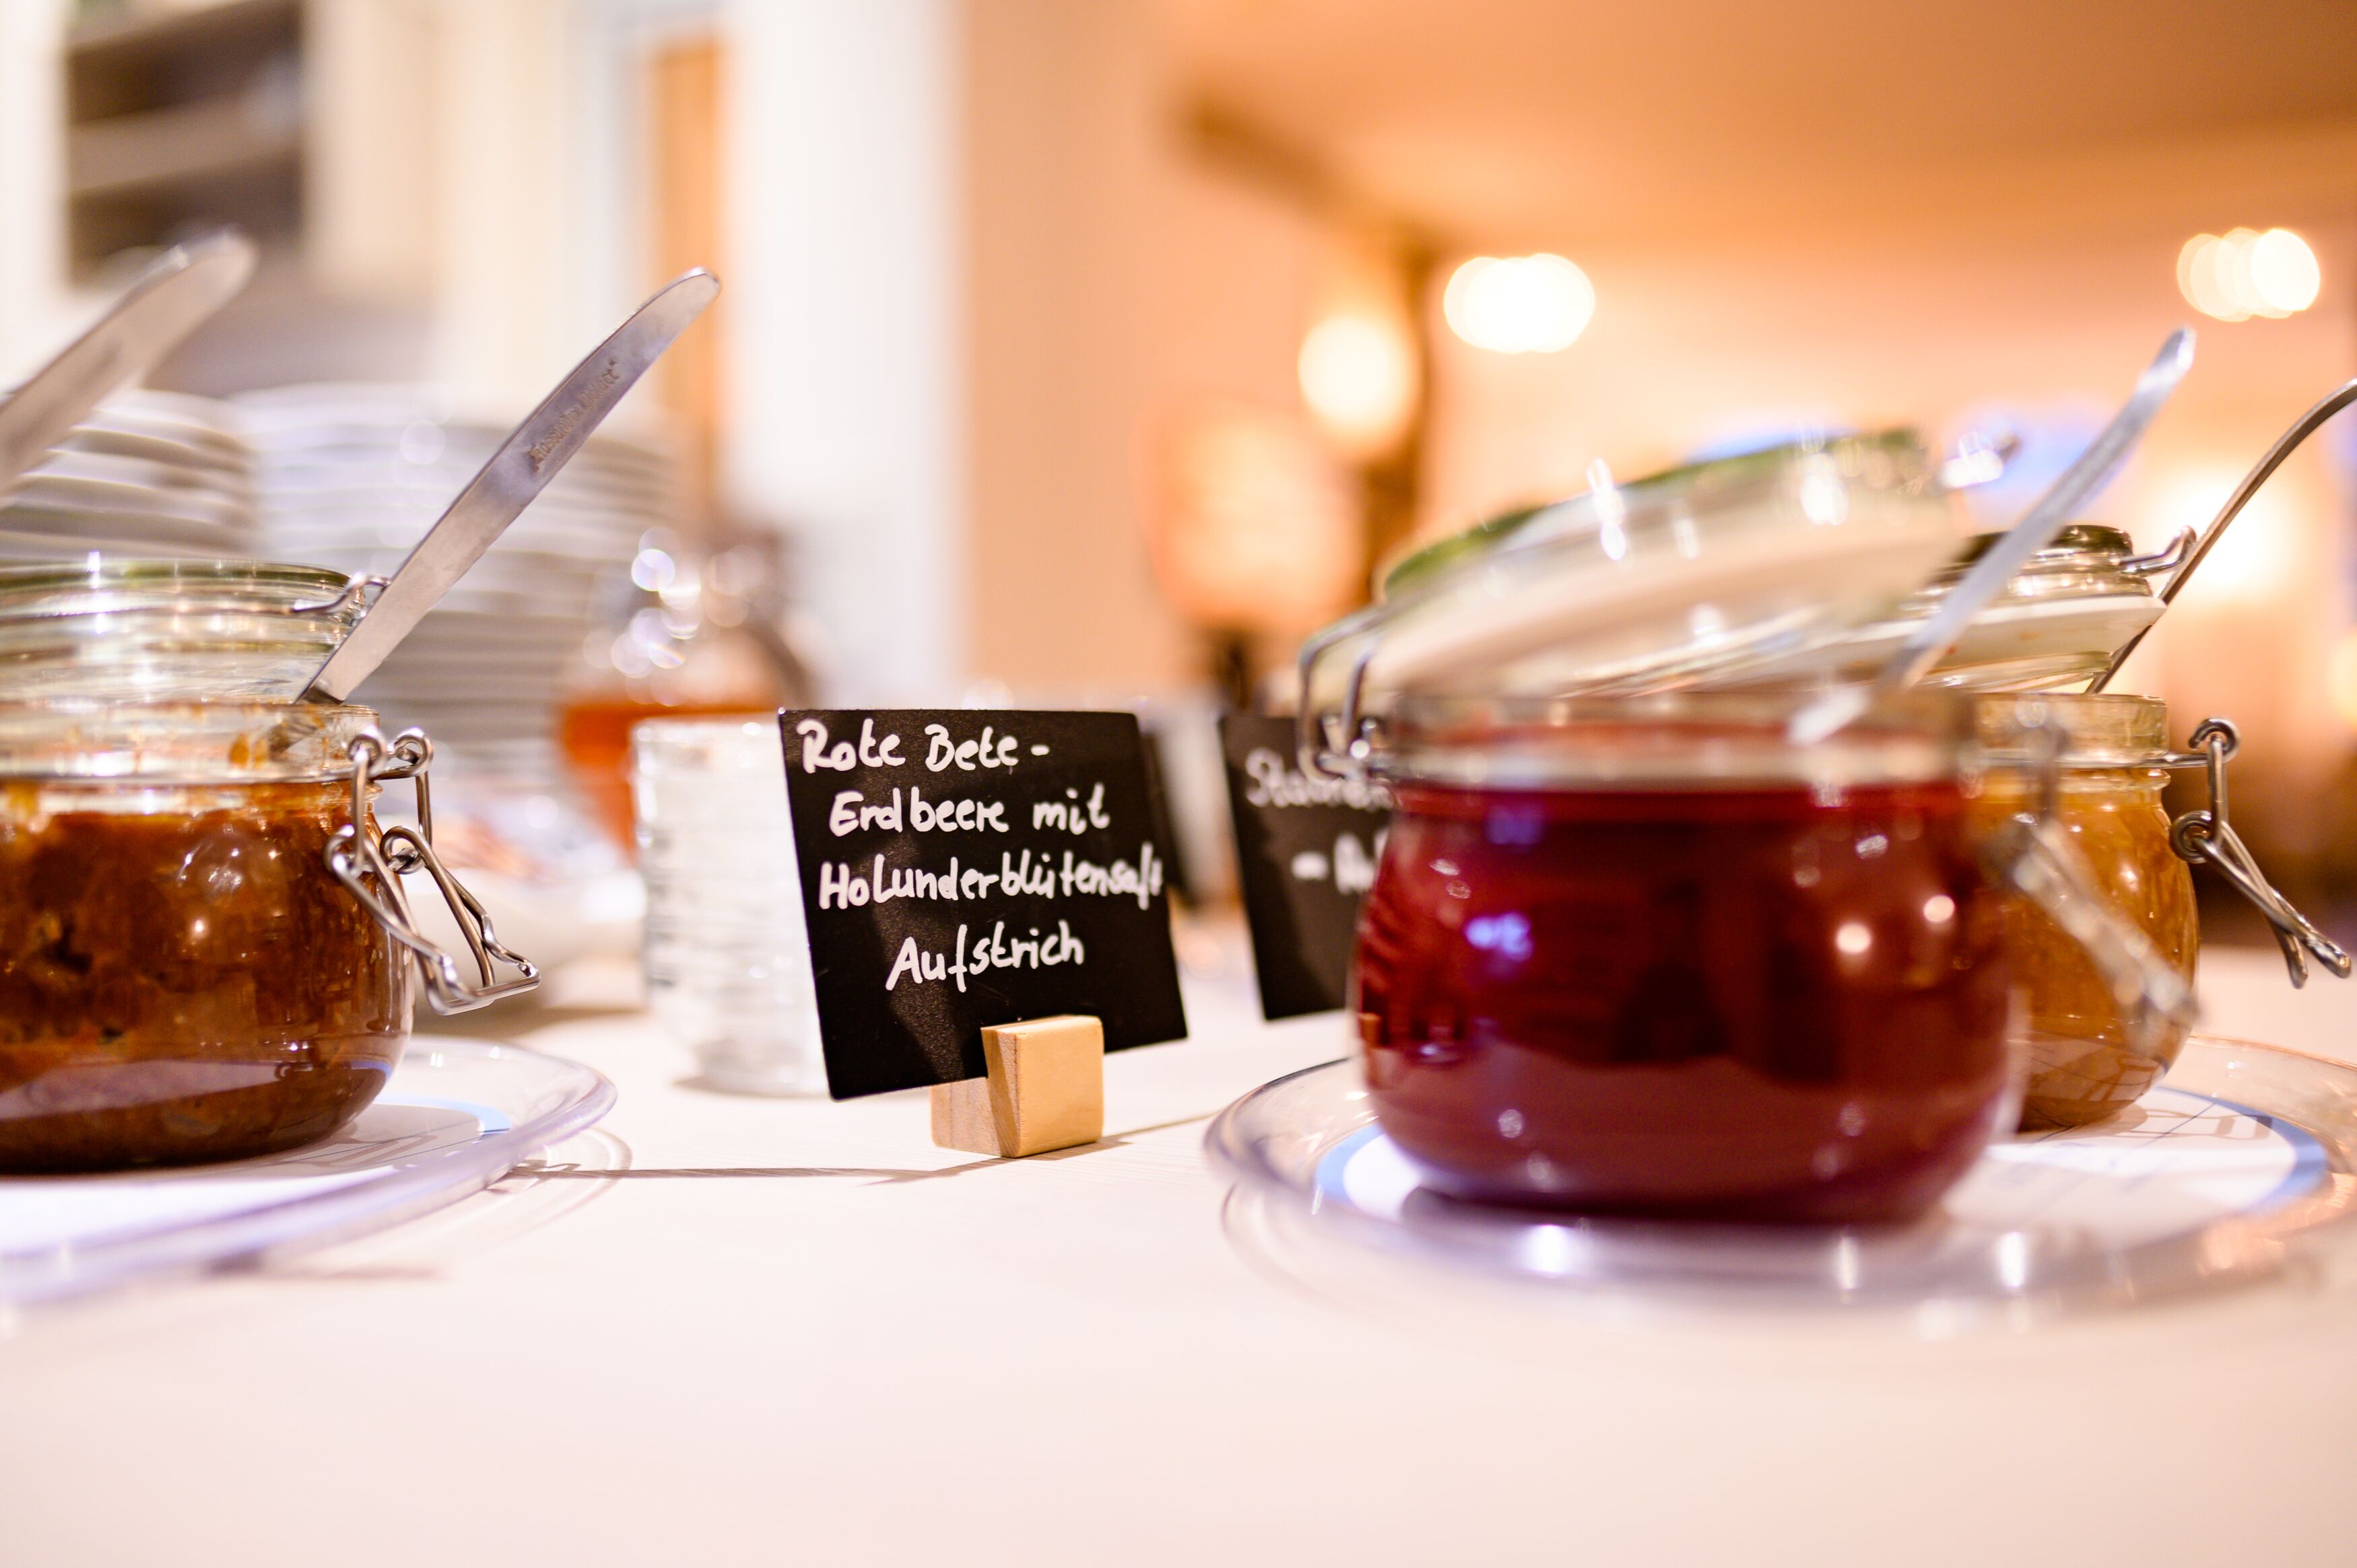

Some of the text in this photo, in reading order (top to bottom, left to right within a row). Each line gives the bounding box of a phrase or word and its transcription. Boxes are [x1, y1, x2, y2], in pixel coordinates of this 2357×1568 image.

[796, 718, 907, 774] Rote
[829, 783, 1110, 837] Erdbeere mit
[885, 920, 1084, 993] Aufstrich
